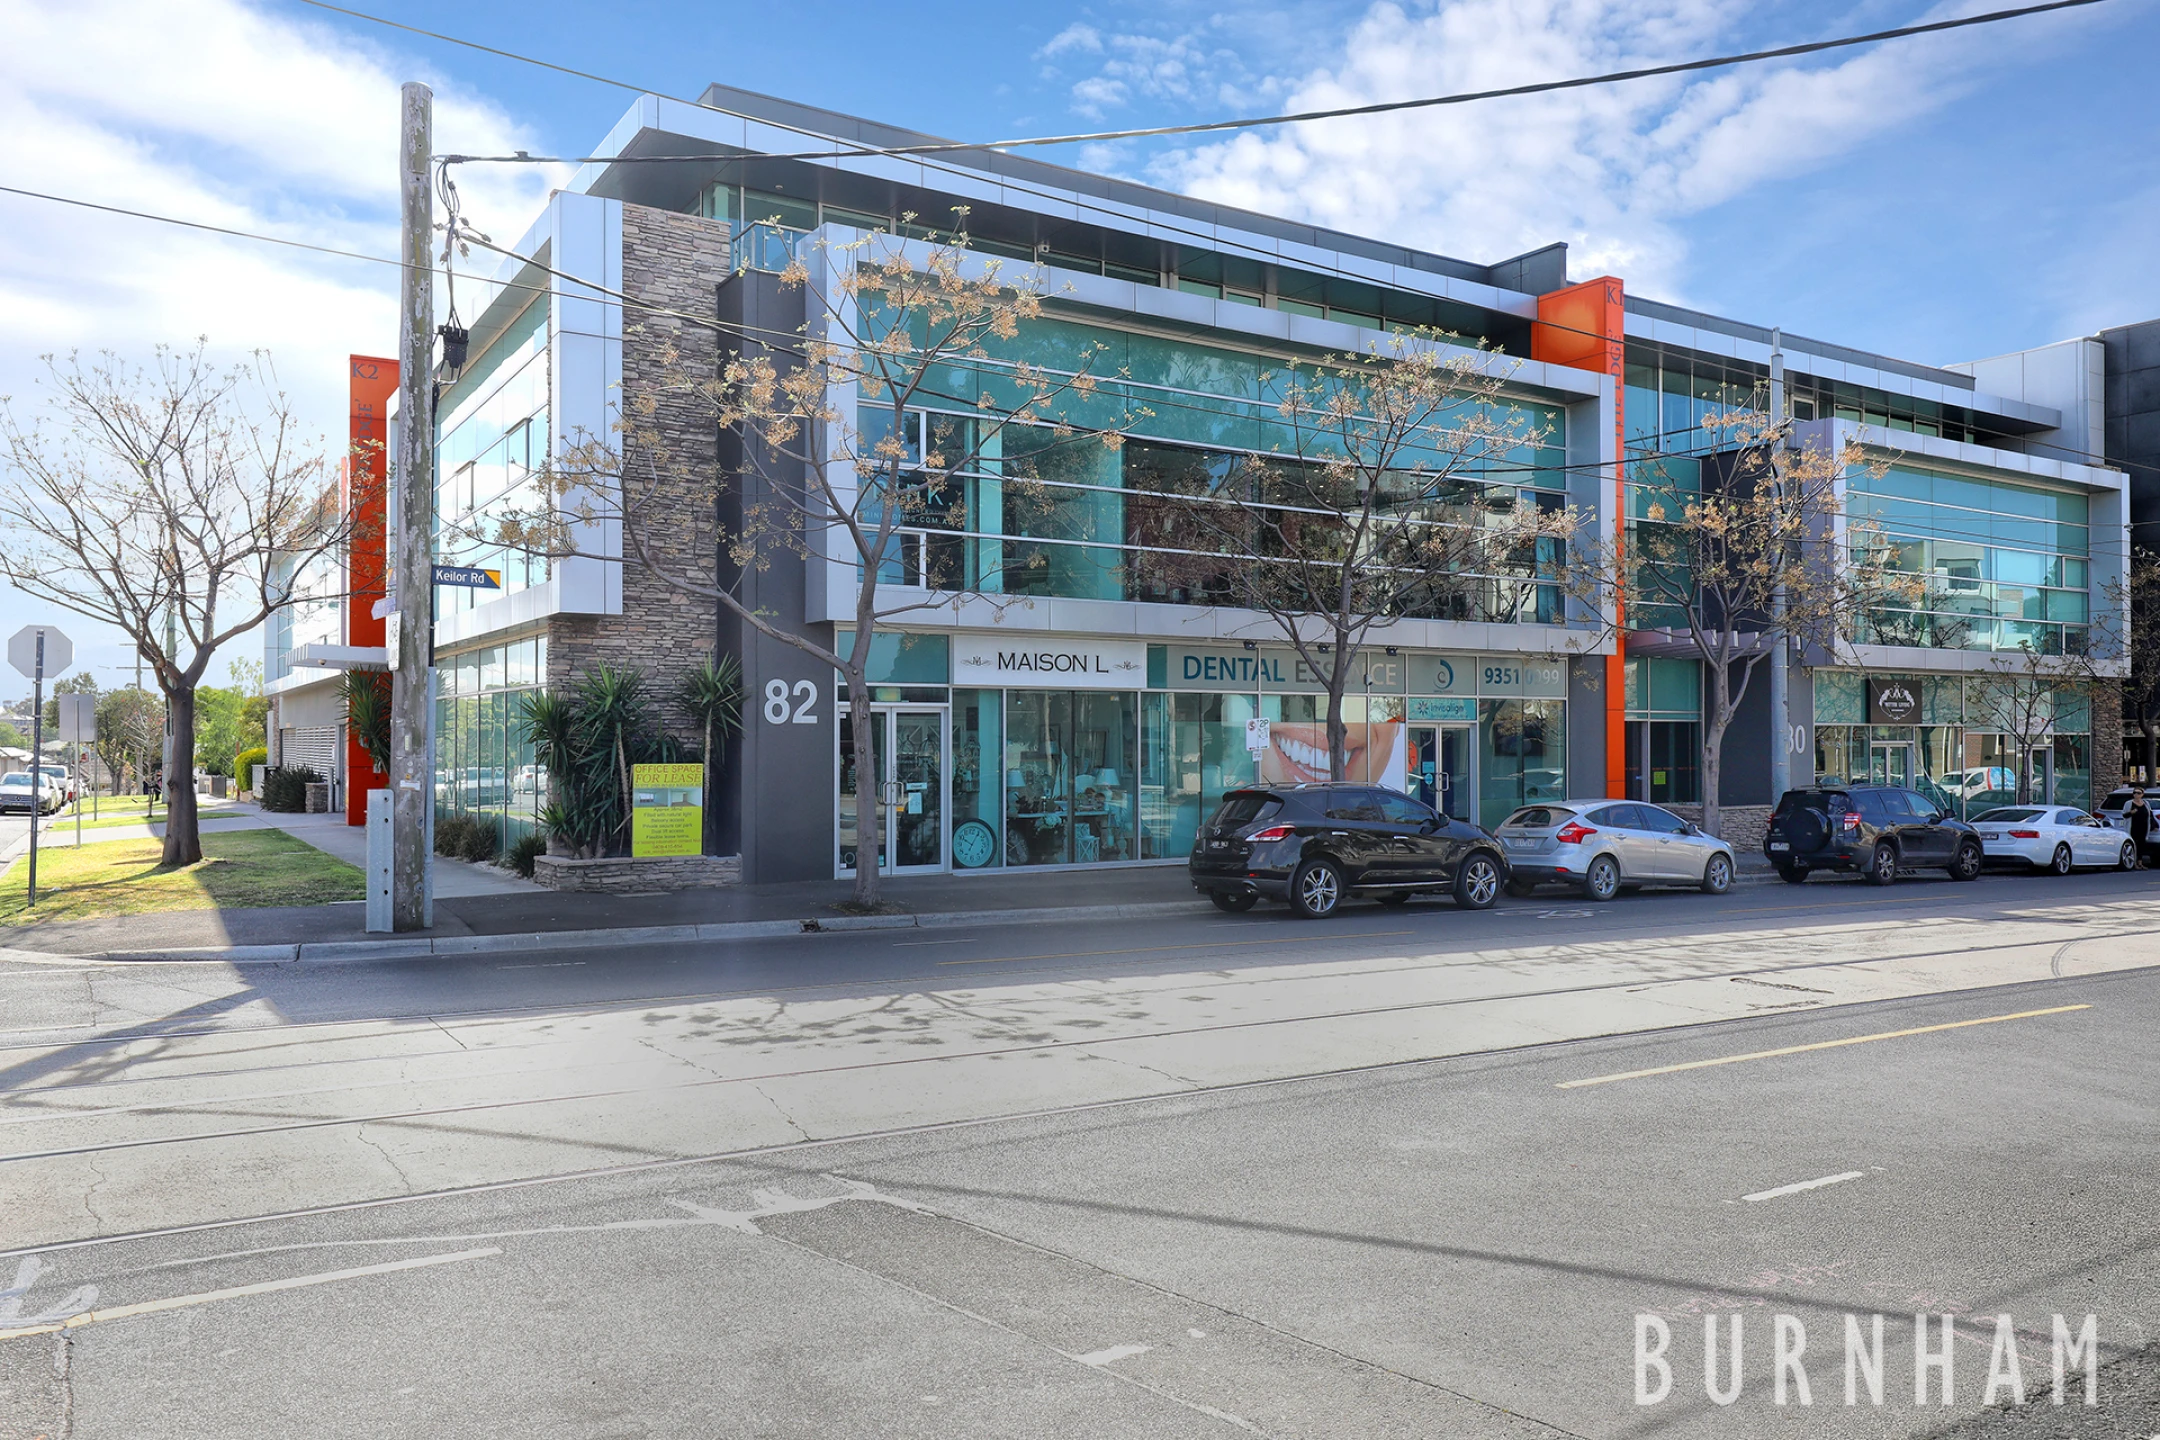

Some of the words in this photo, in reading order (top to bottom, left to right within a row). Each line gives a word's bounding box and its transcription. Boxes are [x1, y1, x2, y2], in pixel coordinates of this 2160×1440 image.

[352, 362, 379, 380] K2
[435, 569, 467, 582] Keilor
[470, 573, 485, 584] Rd
[998, 652, 1088, 673] MAISON
[1095, 655, 1109, 673] L
[1183, 655, 1286, 683] DENTAL
[1295, 659, 1397, 686] ESSNCE
[1484, 667, 1520, 685] 9351
[764, 678, 818, 725] 82
[635, 765, 669, 773] OFFICE
[671, 765, 702, 773] SPACE
[635, 774, 660, 784] FOR
[663, 773, 702, 783] LEASE
